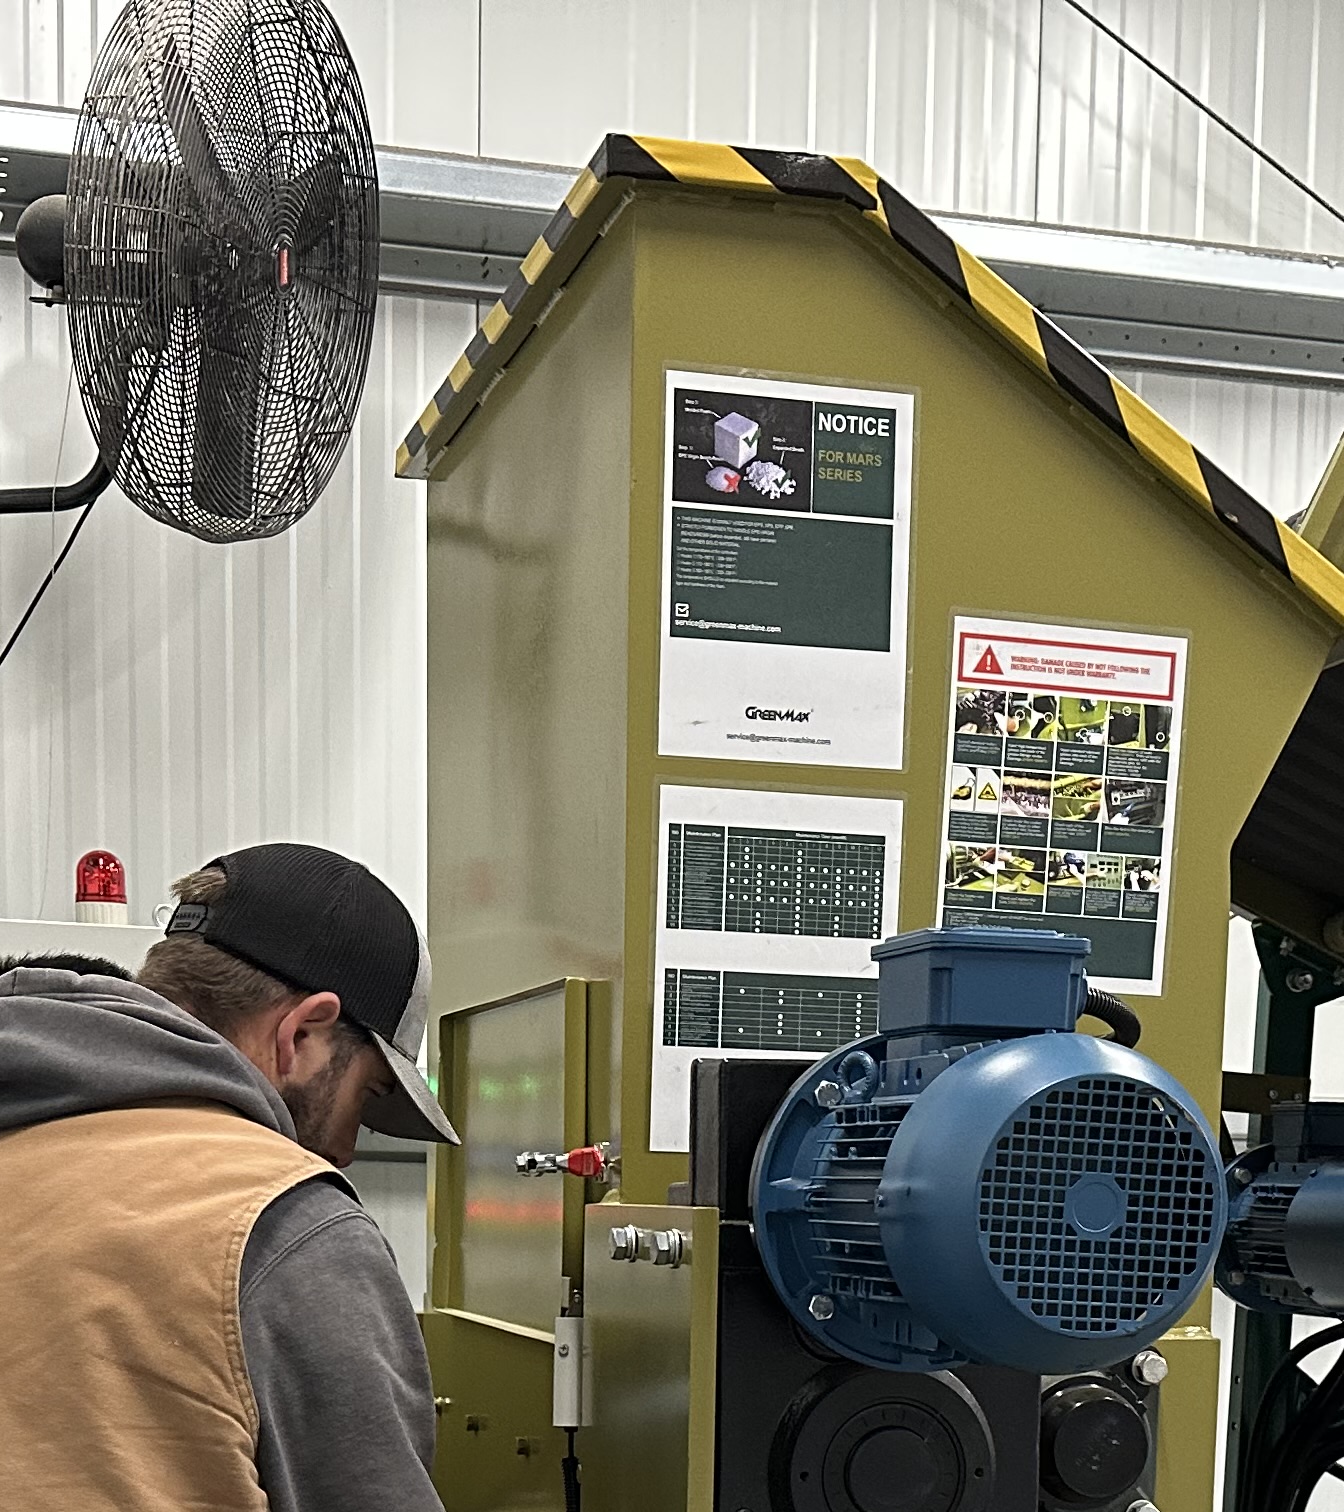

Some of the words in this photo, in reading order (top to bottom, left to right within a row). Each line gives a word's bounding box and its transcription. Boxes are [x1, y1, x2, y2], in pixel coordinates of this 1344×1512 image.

[817, 412, 891, 437] NOTICE
[818, 450, 844, 463] FOR
[846, 452, 883, 467] MARS
[818, 467, 863, 482] SERIES
